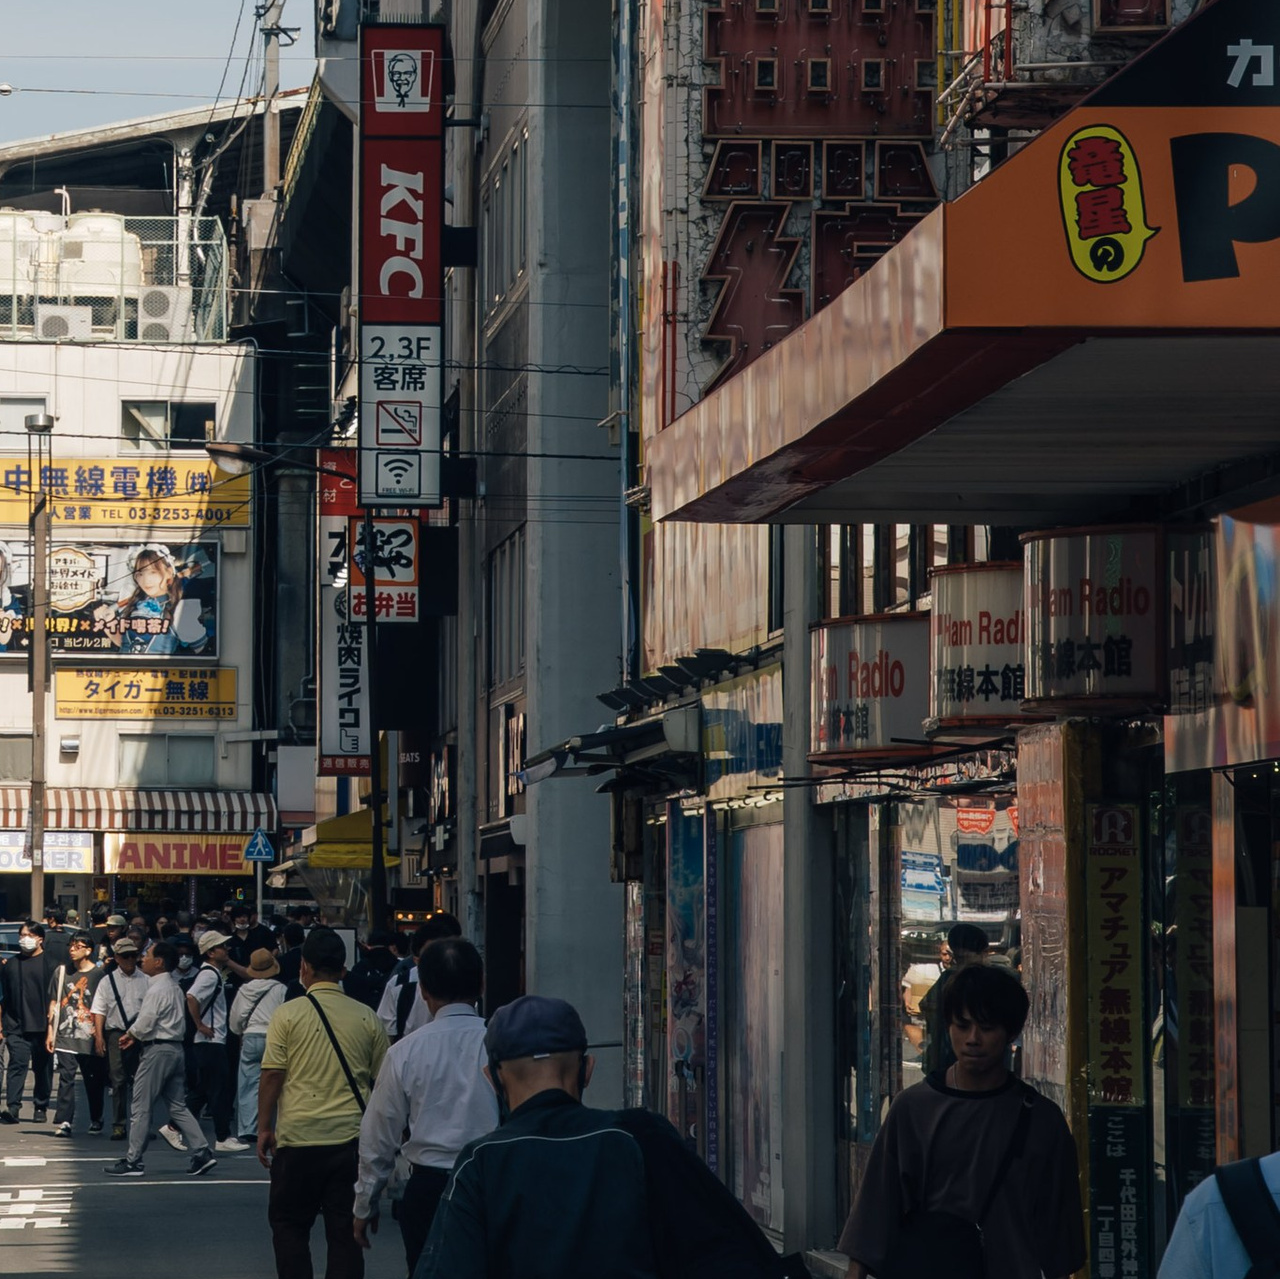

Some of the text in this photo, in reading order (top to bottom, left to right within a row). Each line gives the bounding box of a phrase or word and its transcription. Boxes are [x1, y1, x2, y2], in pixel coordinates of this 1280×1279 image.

[380, 163, 424, 299] KFC
[370, 335, 432, 363] 2,3F
[373, 365, 427, 392] 客席
[102, 506, 232, 521] TEL 03-3253-4001
[1079, 577, 1151, 616] Radio
[84, 679, 209, 700] タイガー無線
[337, 624, 363, 729] 焼肉ライク
[848, 650, 905, 699] Radio
[118, 842, 244, 870] ANIME
[1099, 867, 1132, 1104] アマチュア無線本館
